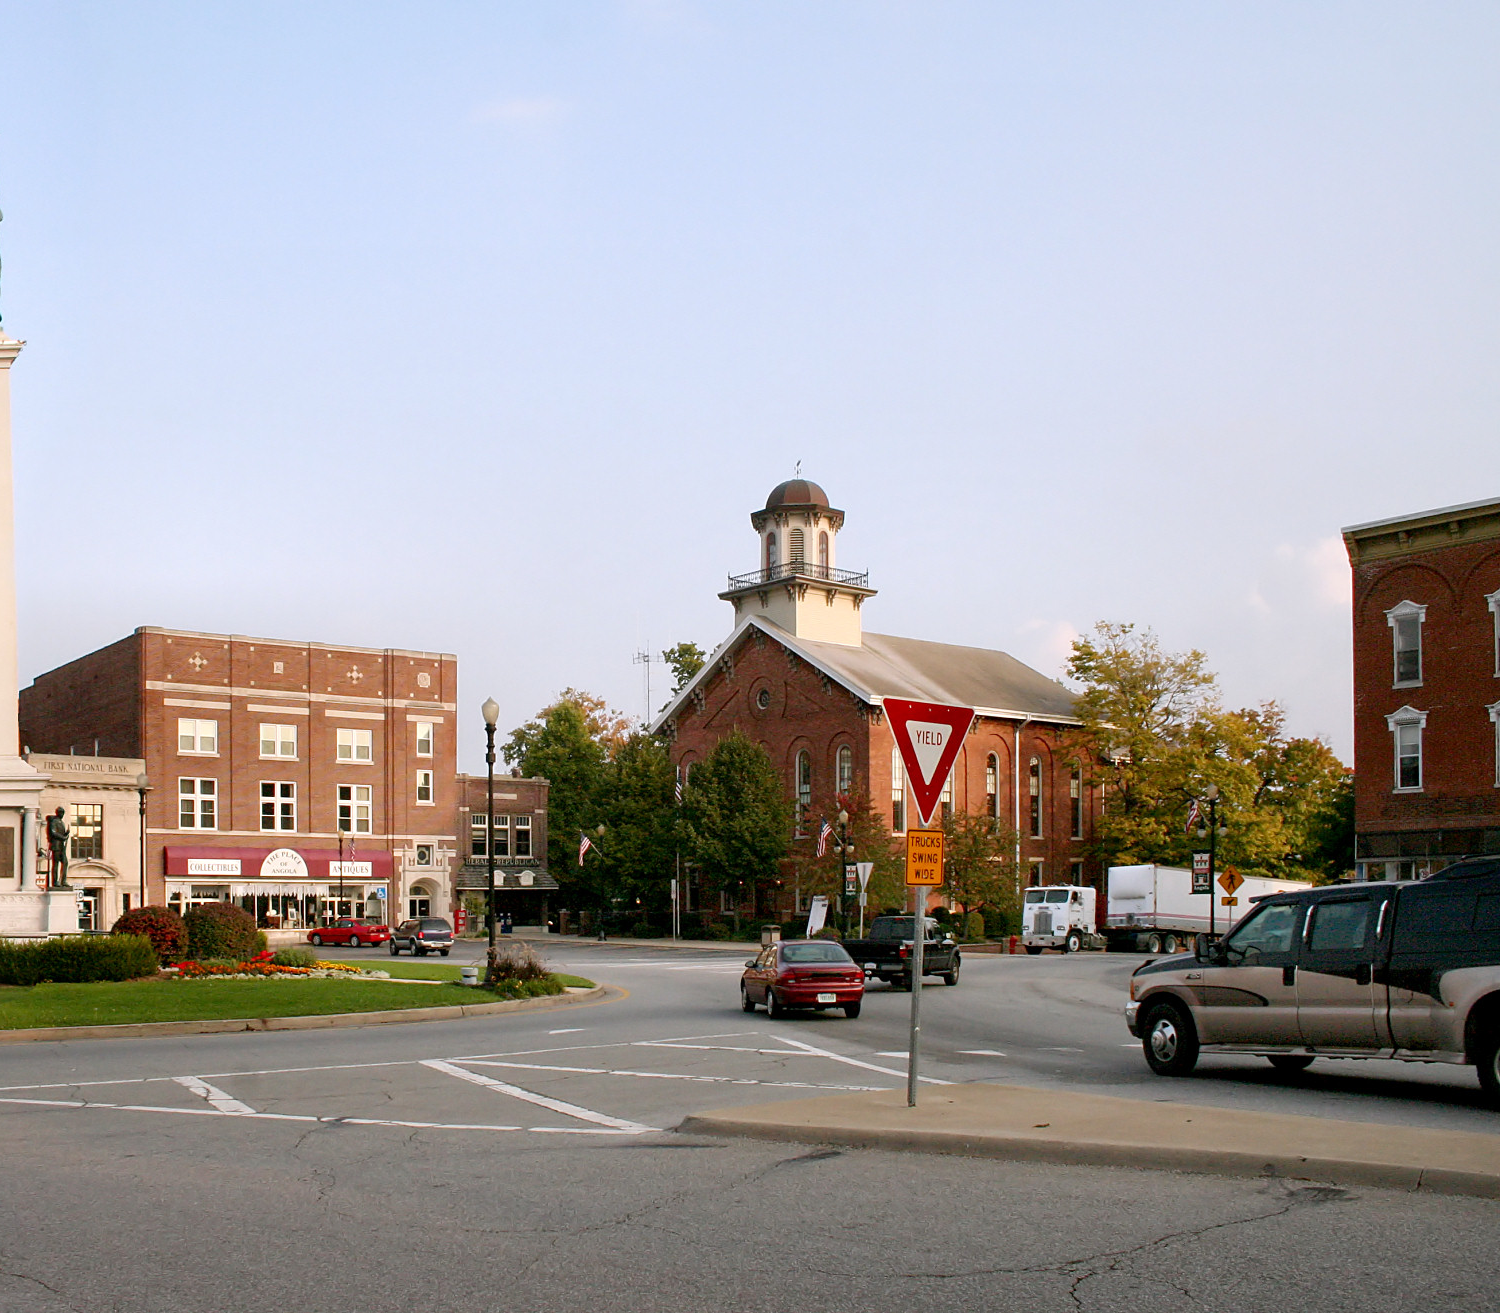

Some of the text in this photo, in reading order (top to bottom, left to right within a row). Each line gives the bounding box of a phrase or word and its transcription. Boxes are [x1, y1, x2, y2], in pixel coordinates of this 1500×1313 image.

[916, 729, 943, 746] YIELD
[43, 761, 130, 774] FIRST NATIONAL BANK
[910, 836, 941, 848] TRUCKS
[267, 851, 302, 865] THE PLACE
[912, 852, 938, 864] SWING
[189, 862, 239, 872] COLLECTIBLES
[332, 865, 369, 874] ANTIQUES
[914, 868, 935, 880] WIDE
